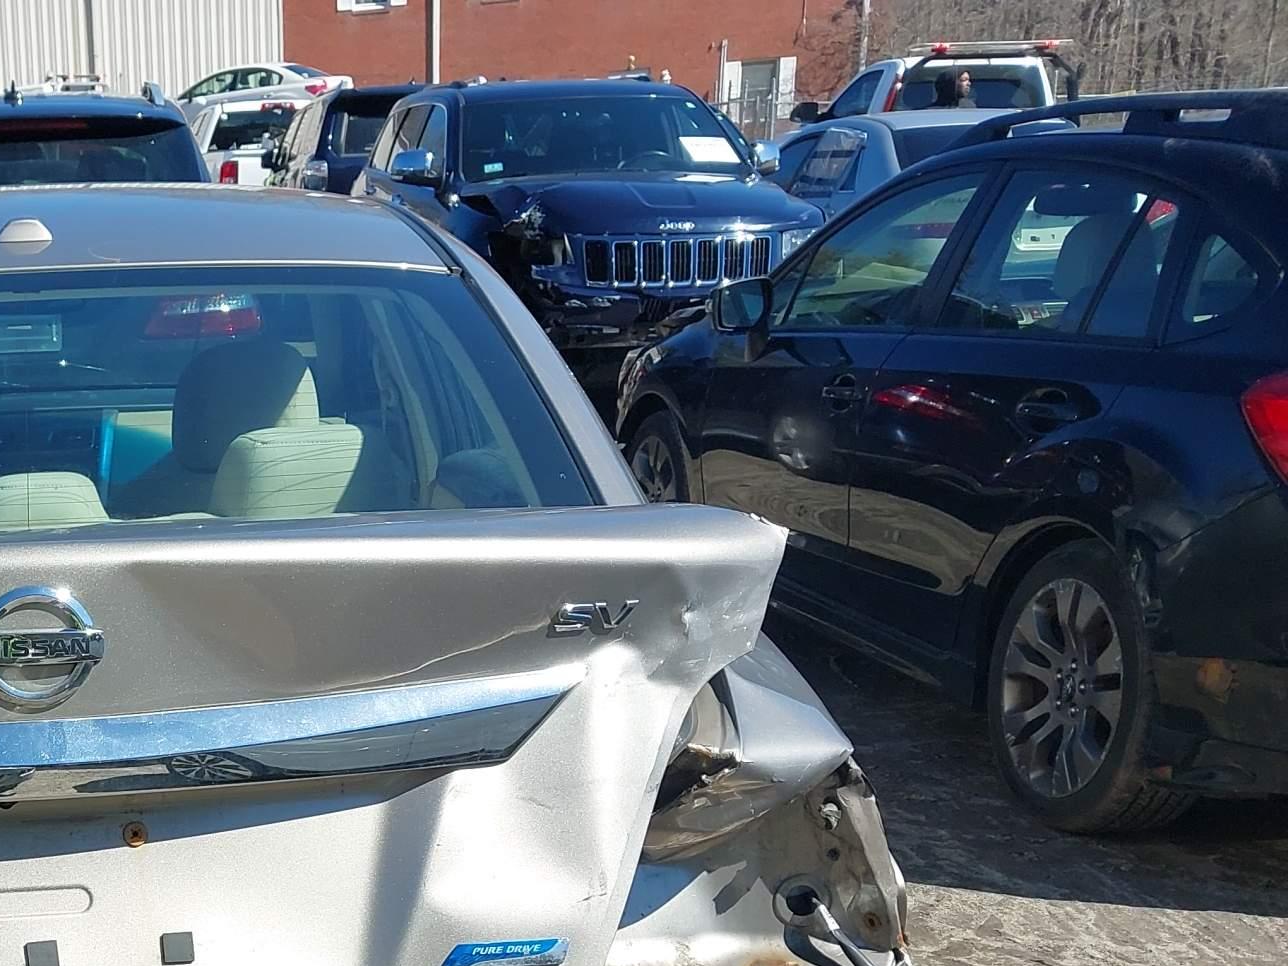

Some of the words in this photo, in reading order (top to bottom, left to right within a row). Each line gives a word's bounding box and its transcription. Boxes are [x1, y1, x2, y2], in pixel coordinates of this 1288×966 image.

[553, 599, 640, 633] SV
[472, 945, 505, 956] PURE
[506, 943, 542, 954] DRIVE
